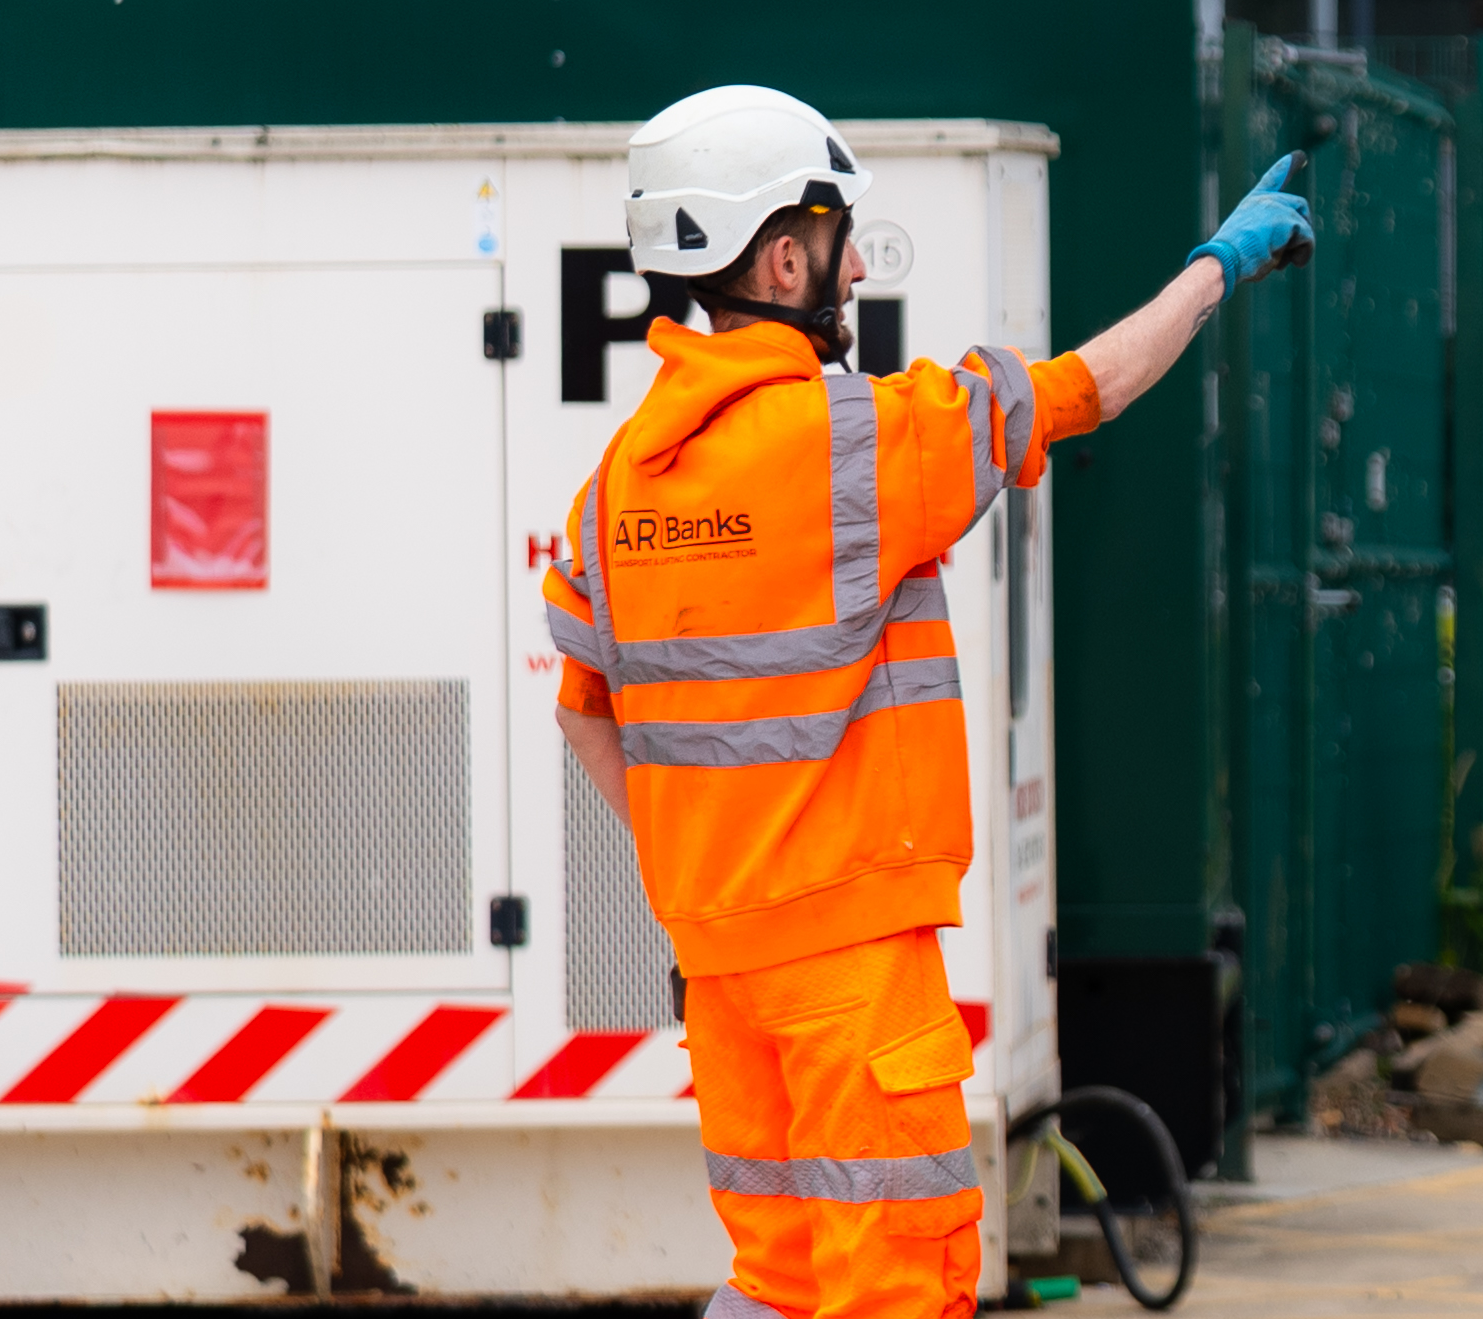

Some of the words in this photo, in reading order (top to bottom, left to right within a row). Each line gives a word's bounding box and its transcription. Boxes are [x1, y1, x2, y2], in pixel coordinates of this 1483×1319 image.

[863, 237, 902, 272] 15
[615, 518, 656, 551] AR
[665, 509, 751, 543] Banks
[686, 548, 757, 562] CONTRACTOR
